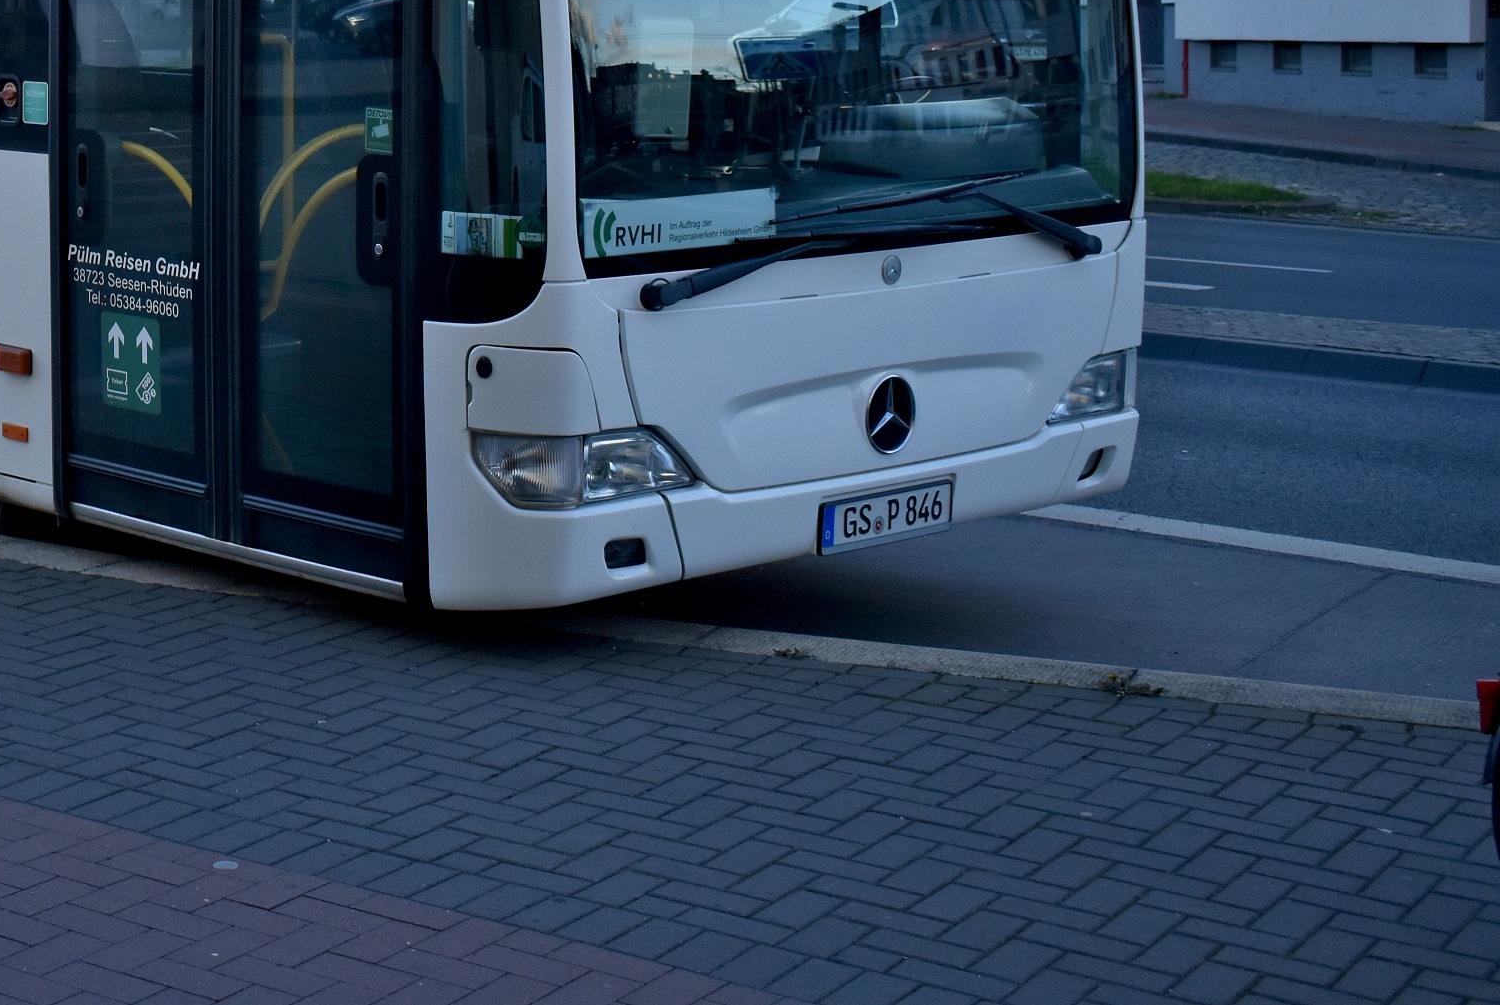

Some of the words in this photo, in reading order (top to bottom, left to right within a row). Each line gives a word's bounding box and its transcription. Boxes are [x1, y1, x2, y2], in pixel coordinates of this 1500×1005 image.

[615, 223, 662, 247] RVHI
[668, 230, 719, 243] Regionalverkehr
[719, 227, 752, 238] Hildesheim
[669, 222, 678, 230] Im
[678, 220, 701, 230] Auftrag
[701, 219, 712, 228] der
[68, 243, 101, 266] Pülm
[105, 249, 152, 273] Reisen
[155, 256, 200, 280] GmbH
[73, 267, 105, 286] 38723
[107, 272, 193, 301] Seesen-Rhüden
[86, 288, 107, 306] Tel.:
[109, 292, 180, 318] 05384-96060
[843, 503, 872, 538] GS
[887, 498, 900, 530] P
[905, 489, 943, 526] 846
[825, 530, 831, 540] D
